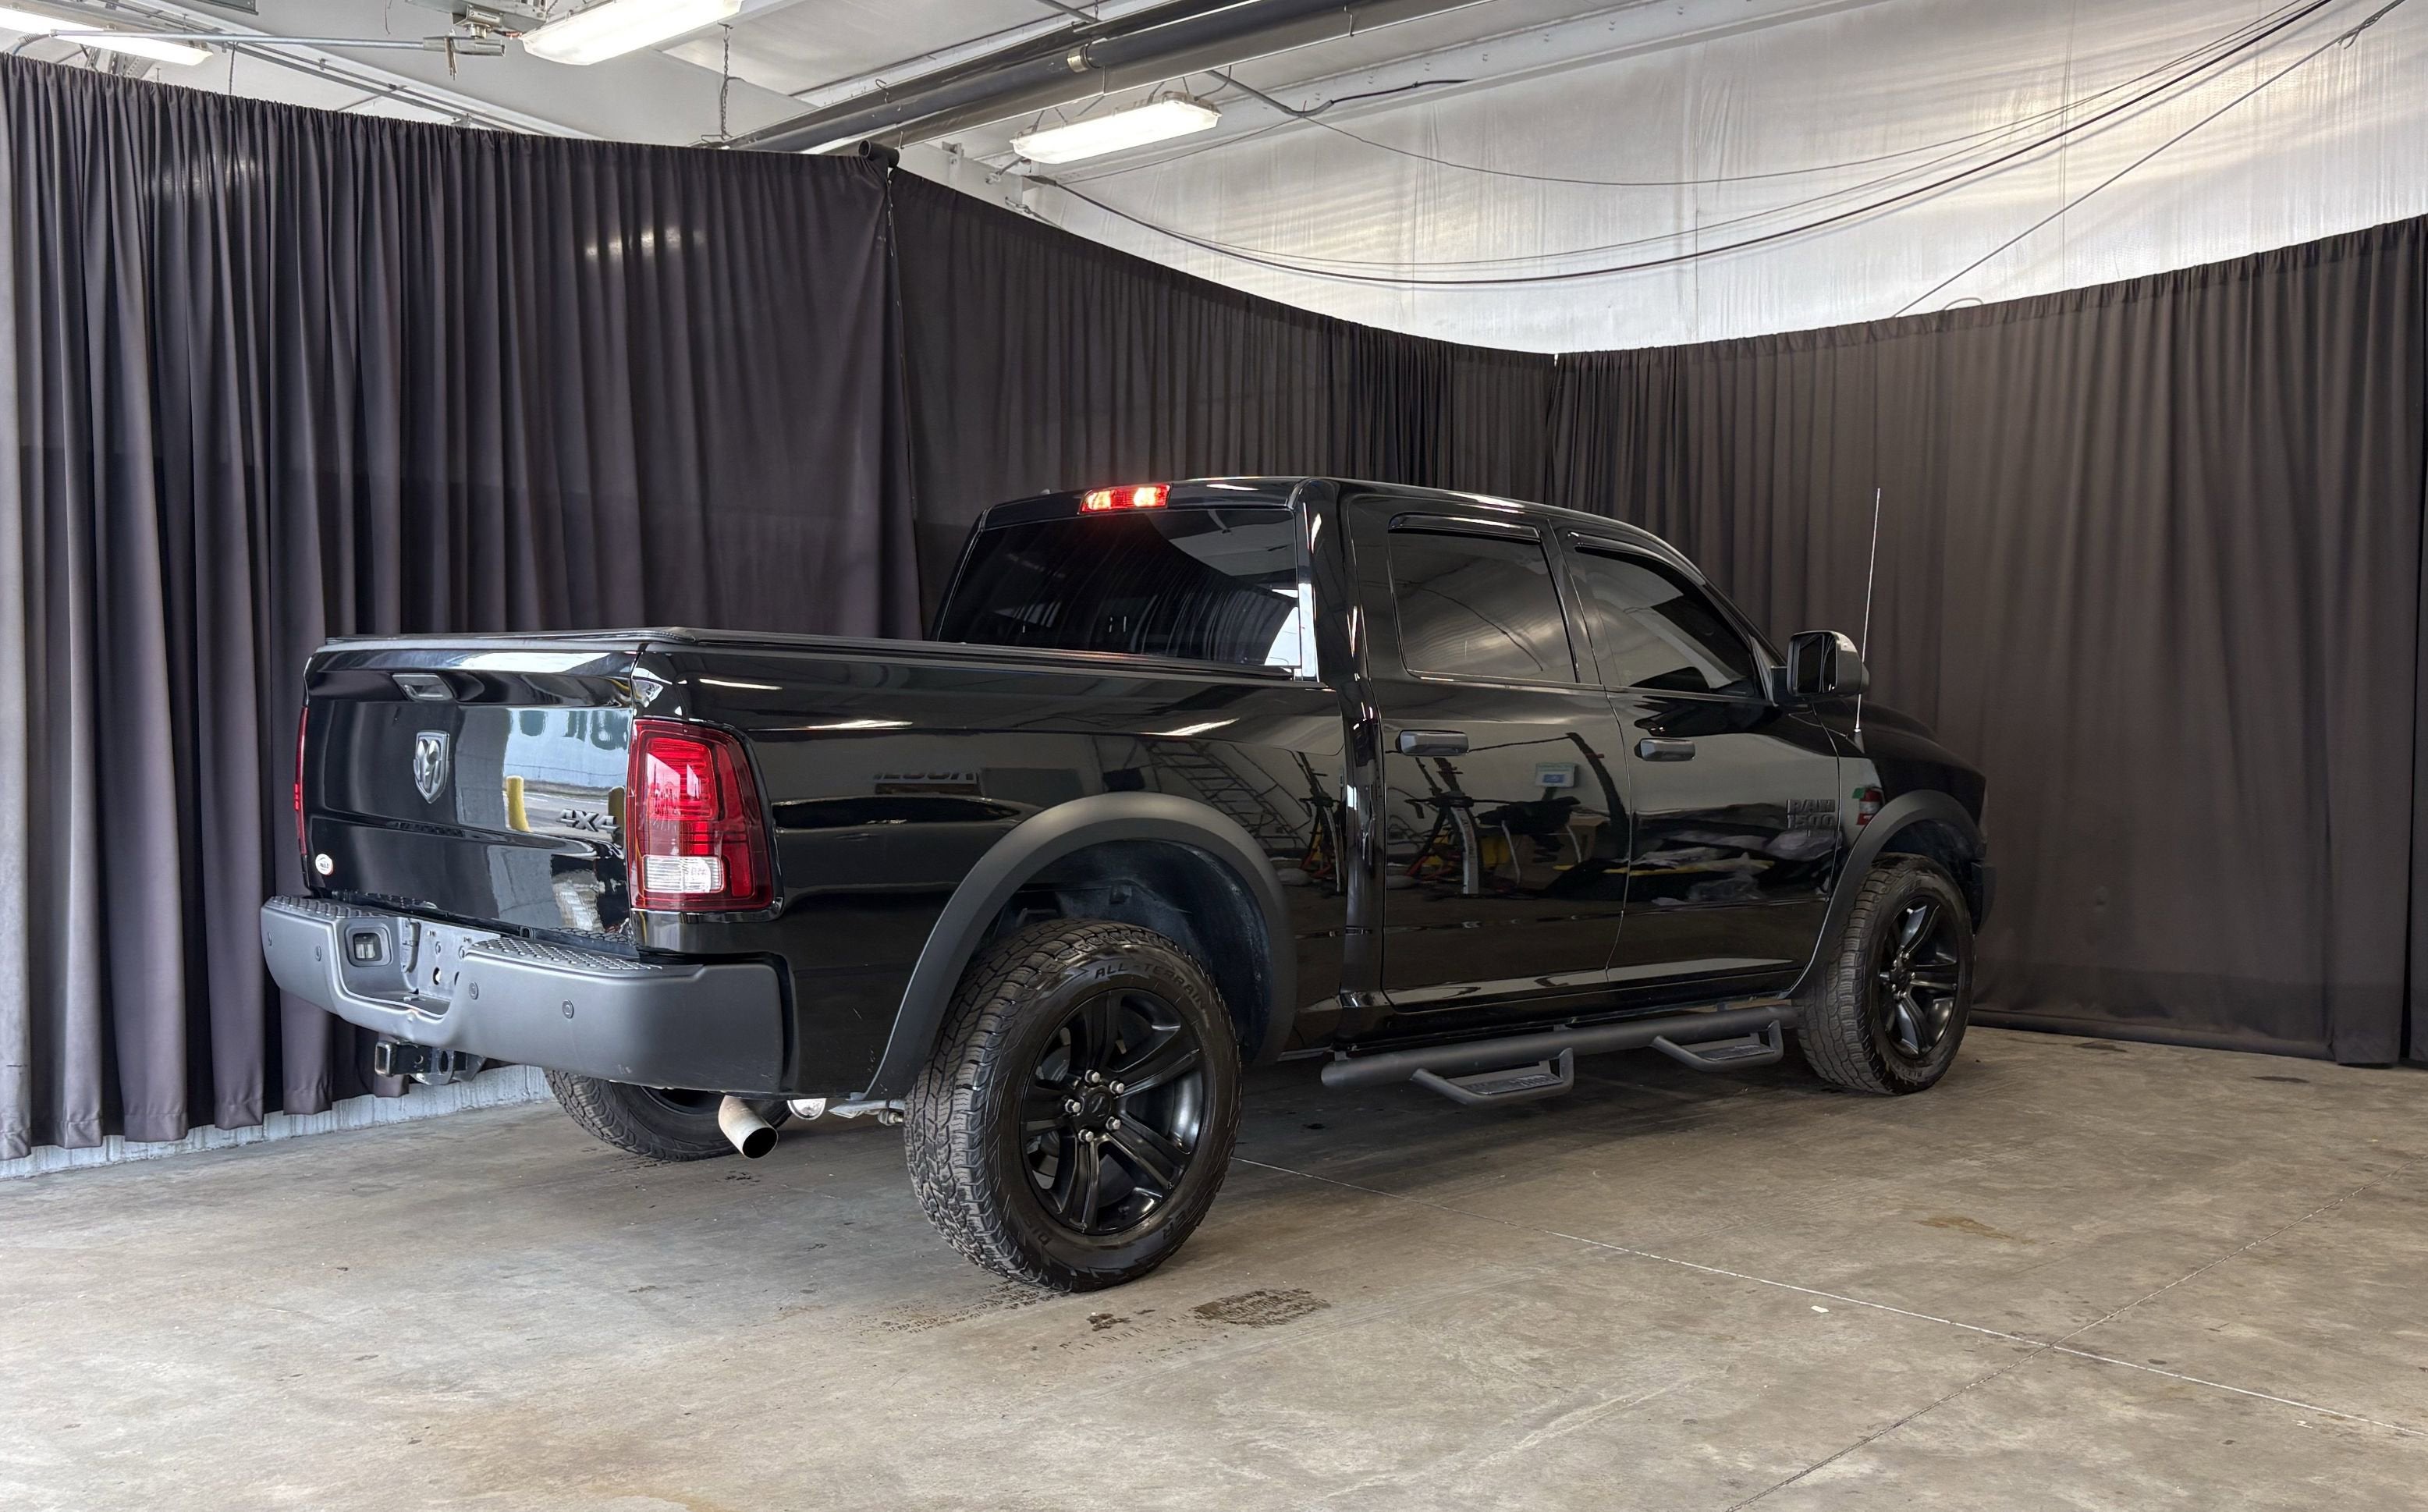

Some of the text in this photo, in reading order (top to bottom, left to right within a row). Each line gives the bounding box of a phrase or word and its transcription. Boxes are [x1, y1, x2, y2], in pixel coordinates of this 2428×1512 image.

[1786, 799, 1836, 813] RAM
[556, 808, 621, 833] 4X4
[1786, 814, 1836, 829] 1500
